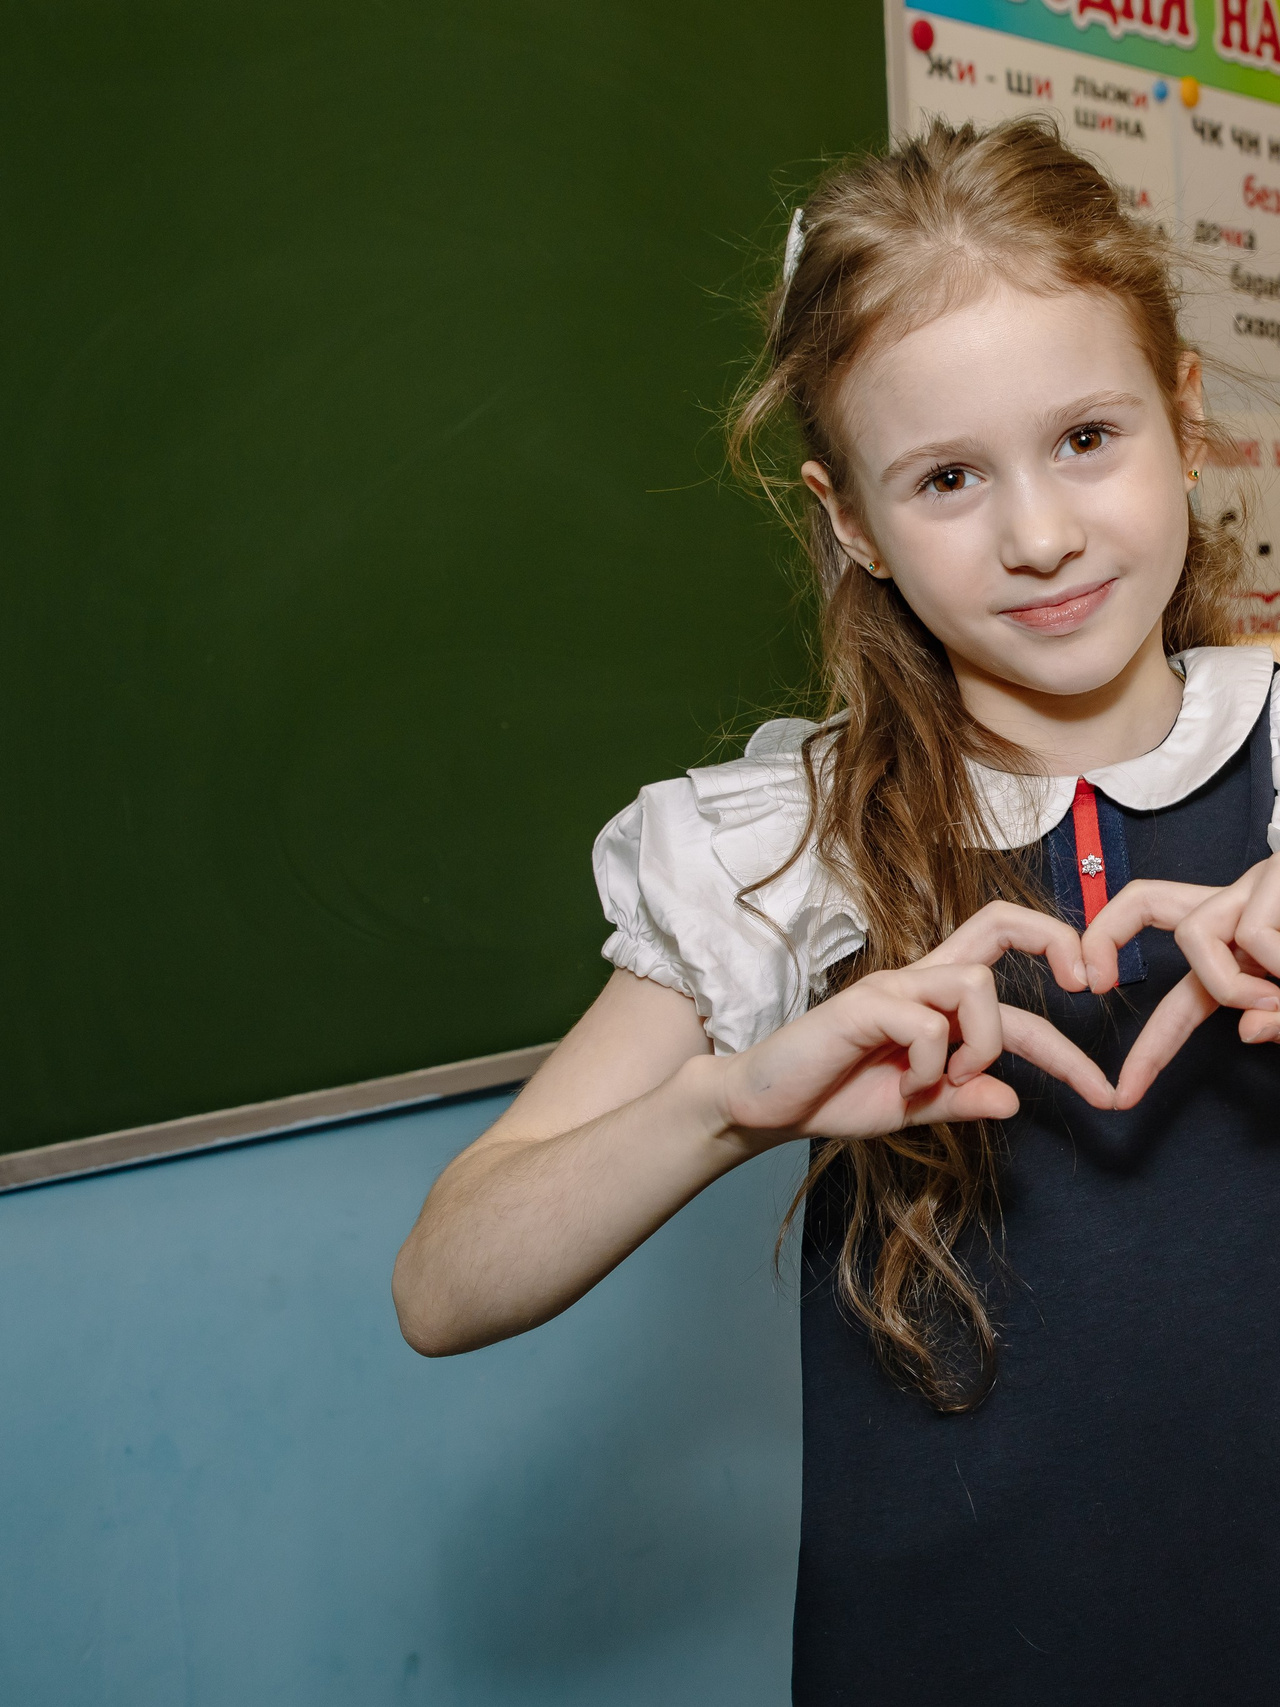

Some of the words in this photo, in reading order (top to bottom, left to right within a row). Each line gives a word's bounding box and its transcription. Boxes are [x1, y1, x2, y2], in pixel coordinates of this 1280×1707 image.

[927, 53, 976, 85] ЖИ
[1006, 68, 1052, 99] ШИ
[1075, 107, 1146, 140] ШИНА
